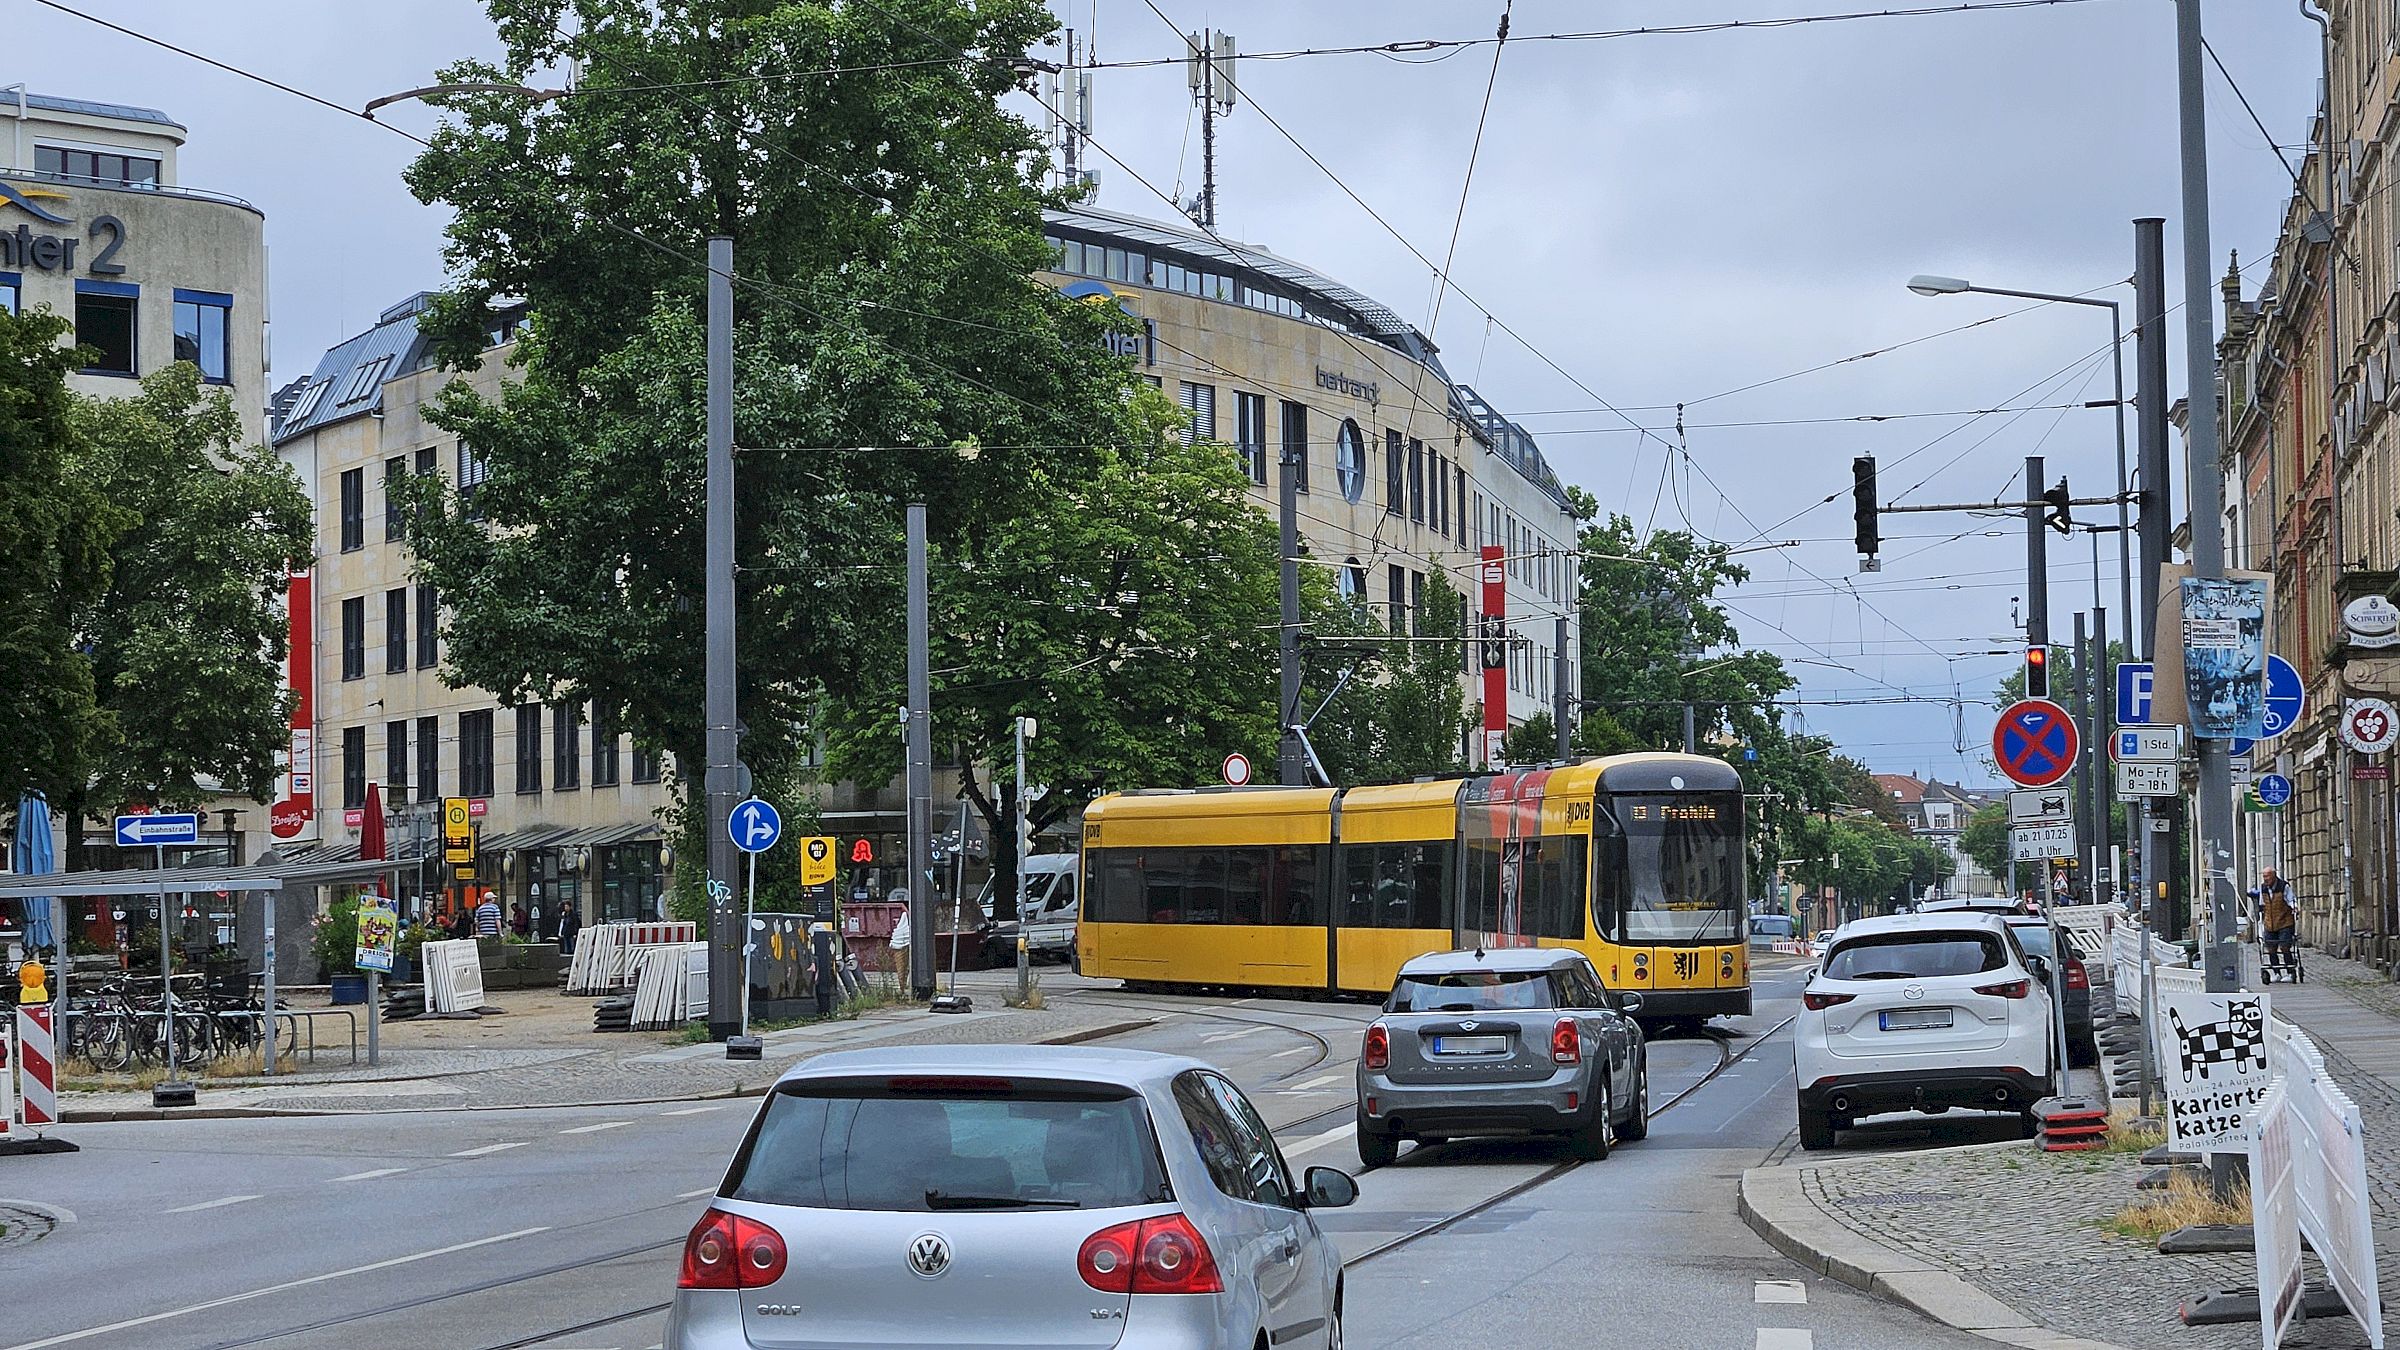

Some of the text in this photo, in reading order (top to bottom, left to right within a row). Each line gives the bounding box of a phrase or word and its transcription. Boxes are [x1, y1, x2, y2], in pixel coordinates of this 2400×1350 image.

[90, 215, 126, 274] 2
[2128, 766, 2144, 778] Mo
[2156, 766, 2169, 778] Fr
[2128, 780, 2135, 790] 8
[1574, 802, 1590, 821] DVB
[140, 825, 192, 834] Einbahnstraße
[2018, 832, 2029, 842] ab
[2019, 845, 2062, 858] ab 0 Uhr
[1408, 1063, 1532, 1072] COUNTRYMAN
[756, 1304, 801, 1316] GOLF
